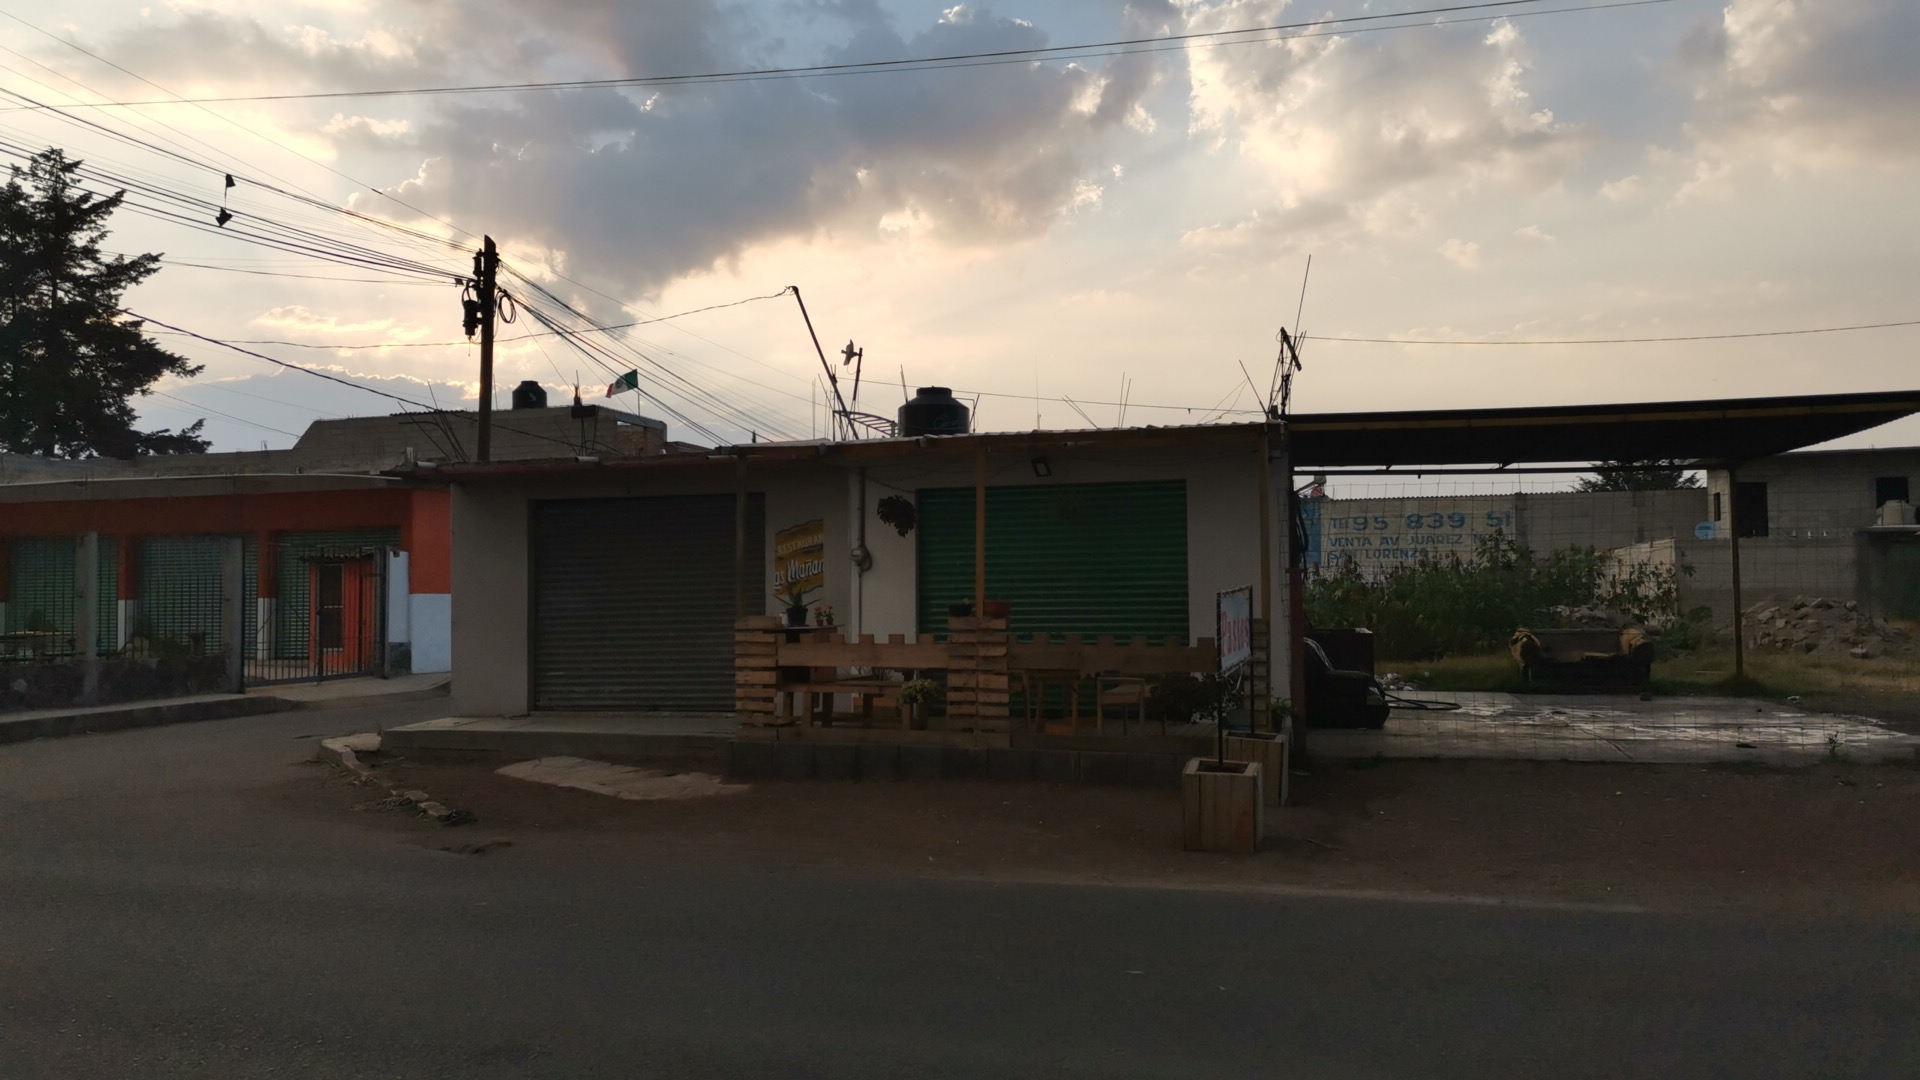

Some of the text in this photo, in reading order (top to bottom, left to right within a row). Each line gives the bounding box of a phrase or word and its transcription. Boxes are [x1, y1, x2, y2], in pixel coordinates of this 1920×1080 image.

[1352, 516, 1388, 531] 95
[1406, 512, 1466, 530] 839
[1330, 536, 1372, 547] VENTA
[1380, 536, 1400, 546] AV
[1408, 534, 1463, 545] JUAREZ
[1365, 547, 1429, 559] LORENZO
